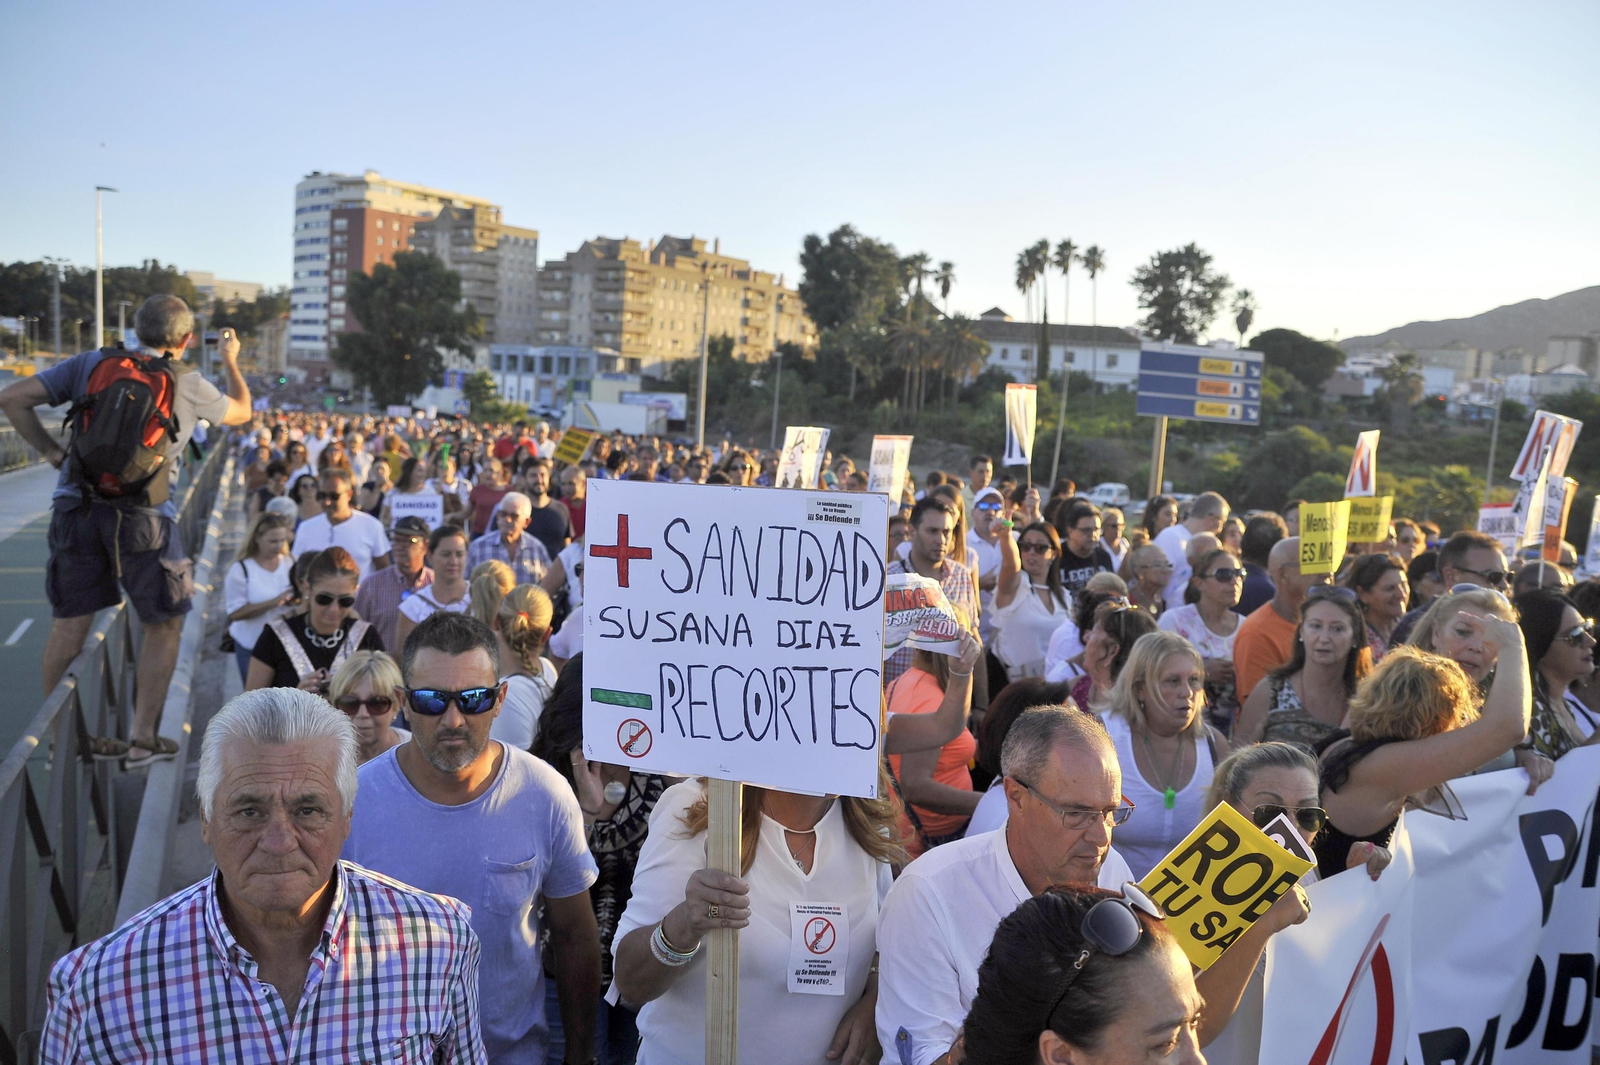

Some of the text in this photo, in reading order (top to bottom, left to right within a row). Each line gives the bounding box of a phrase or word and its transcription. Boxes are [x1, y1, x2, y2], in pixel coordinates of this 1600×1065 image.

[815, 513, 824, 521] Se
[824, 514, 853, 524] Defiende
[660, 517, 885, 611] SANIDAD
[1301, 542, 1316, 563] ES
[599, 606, 861, 650] SUSANA DIAZ
[917, 618, 957, 637] 19:00
[660, 662, 880, 751] RECORTES
[1146, 867, 1203, 918] TU
[801, 968, 808, 976] Se
[808, 969, 831, 977] Defiende
